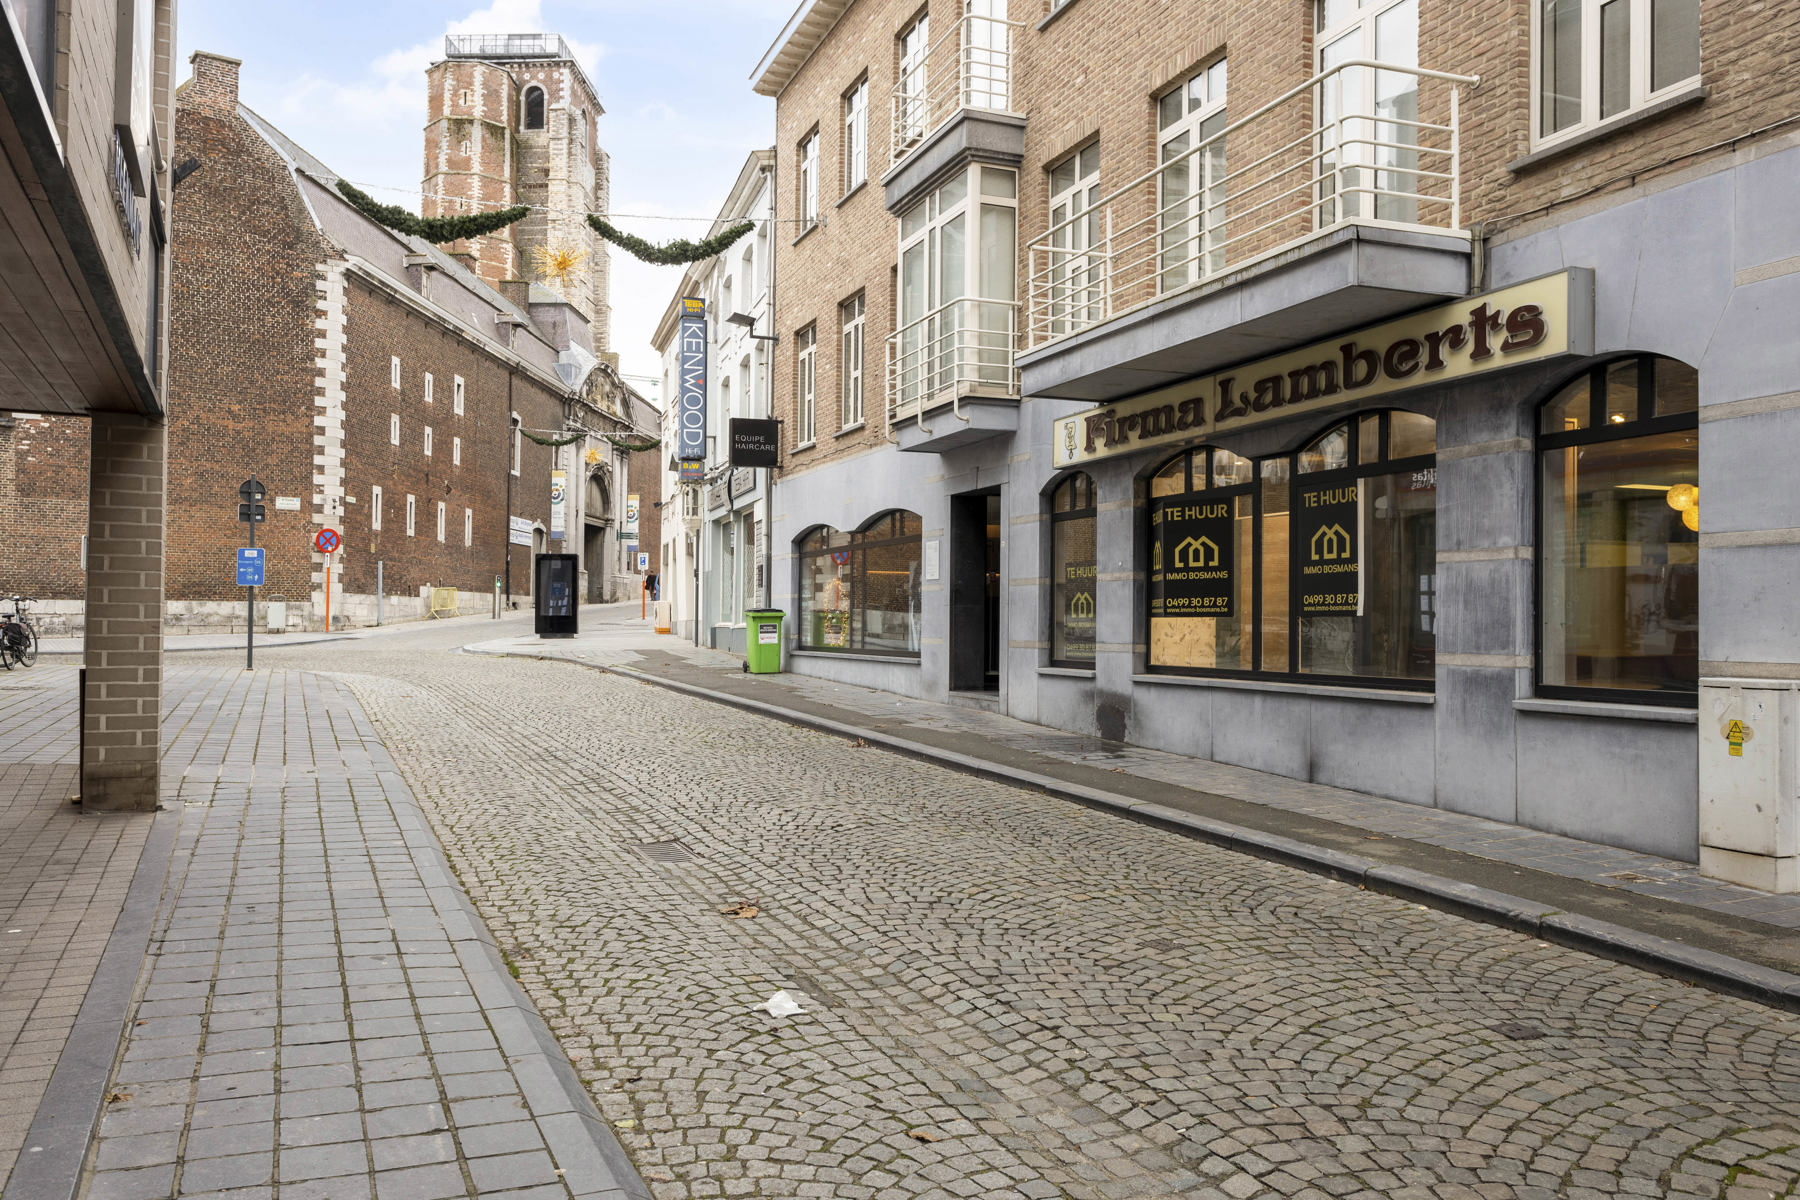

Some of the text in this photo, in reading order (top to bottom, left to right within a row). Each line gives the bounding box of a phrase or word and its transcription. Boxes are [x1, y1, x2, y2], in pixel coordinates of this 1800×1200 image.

[1084, 301, 1549, 453] Firma Lamberts
[683, 323, 704, 446] KENWOOD
[735, 434, 765, 443] EQUIPE
[735, 443, 776, 452] HAIRCARE
[1303, 487, 1358, 508] TE HUUR
[1165, 507, 1182, 521] TE
[1185, 504, 1229, 520] HUUR
[1066, 567, 1076, 579] TE
[1303, 563, 1358, 575] IMMO BOSMANS
[1166, 572, 1188, 581] IMMO
[1188, 570, 1229, 580] BOSMANS
[1166, 597, 1189, 607] 0499
[1190, 597, 1202, 606] 30
[1203, 597, 1215, 606] 87
[1216, 597, 1229, 606] 87
[1303, 593, 1358, 605] 0499 30 87 87
